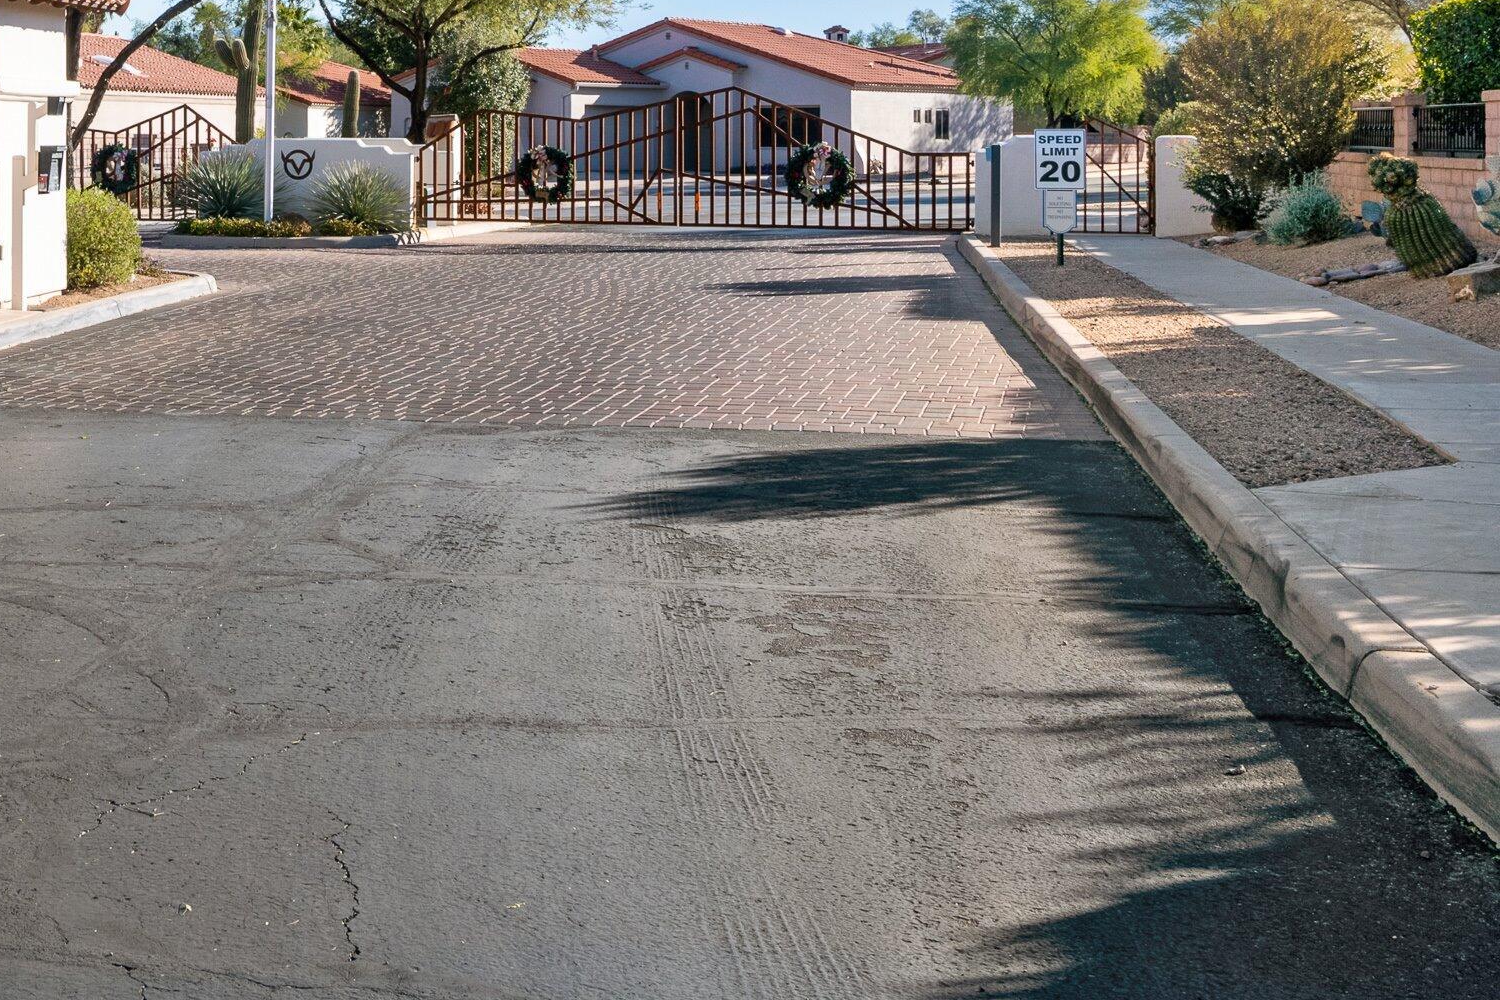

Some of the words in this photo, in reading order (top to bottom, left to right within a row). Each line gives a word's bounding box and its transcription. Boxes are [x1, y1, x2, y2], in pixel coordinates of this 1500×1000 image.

[1038, 135, 1082, 144] SPEED
[1041, 147, 1079, 156] LIMIT
[1039, 160, 1081, 183] 20
